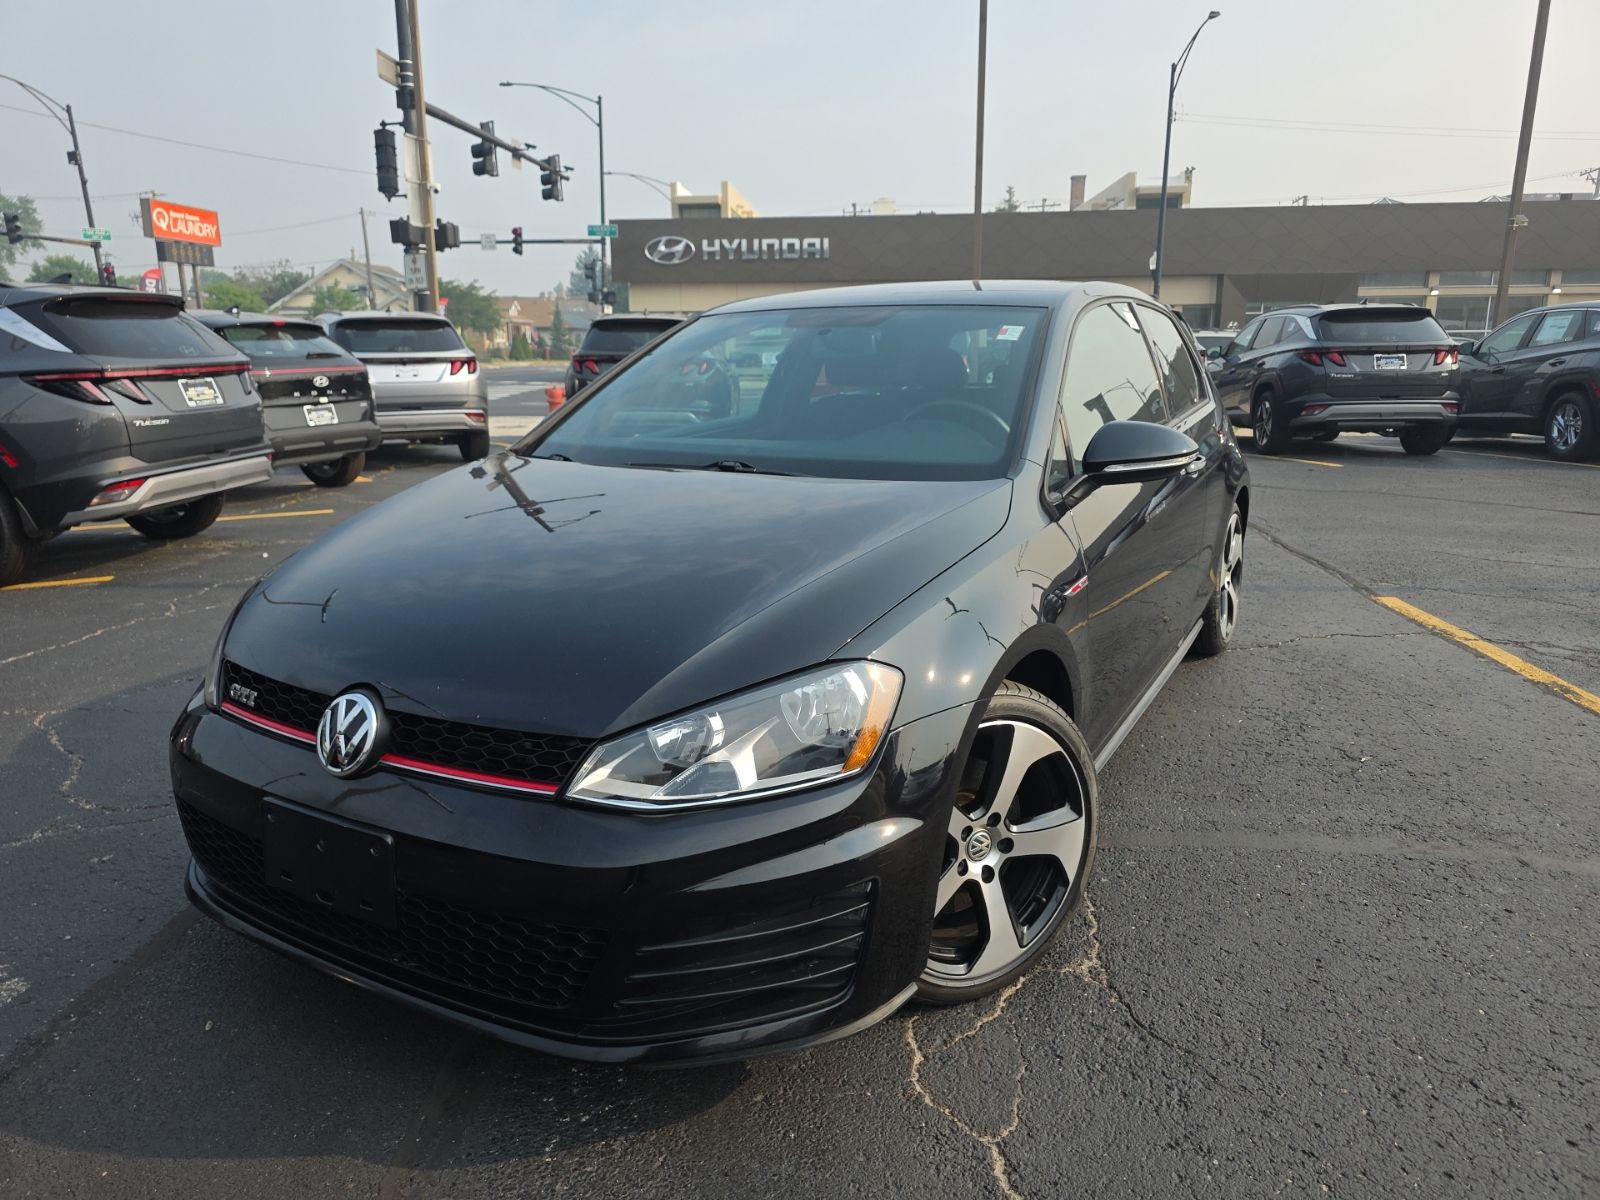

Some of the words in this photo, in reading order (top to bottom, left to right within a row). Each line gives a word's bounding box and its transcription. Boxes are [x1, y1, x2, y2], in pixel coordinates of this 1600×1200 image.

[169, 217, 217, 239] LAUNDRY
[701, 237, 830, 260] HYUNDAI
[230, 682, 259, 707] GTI
